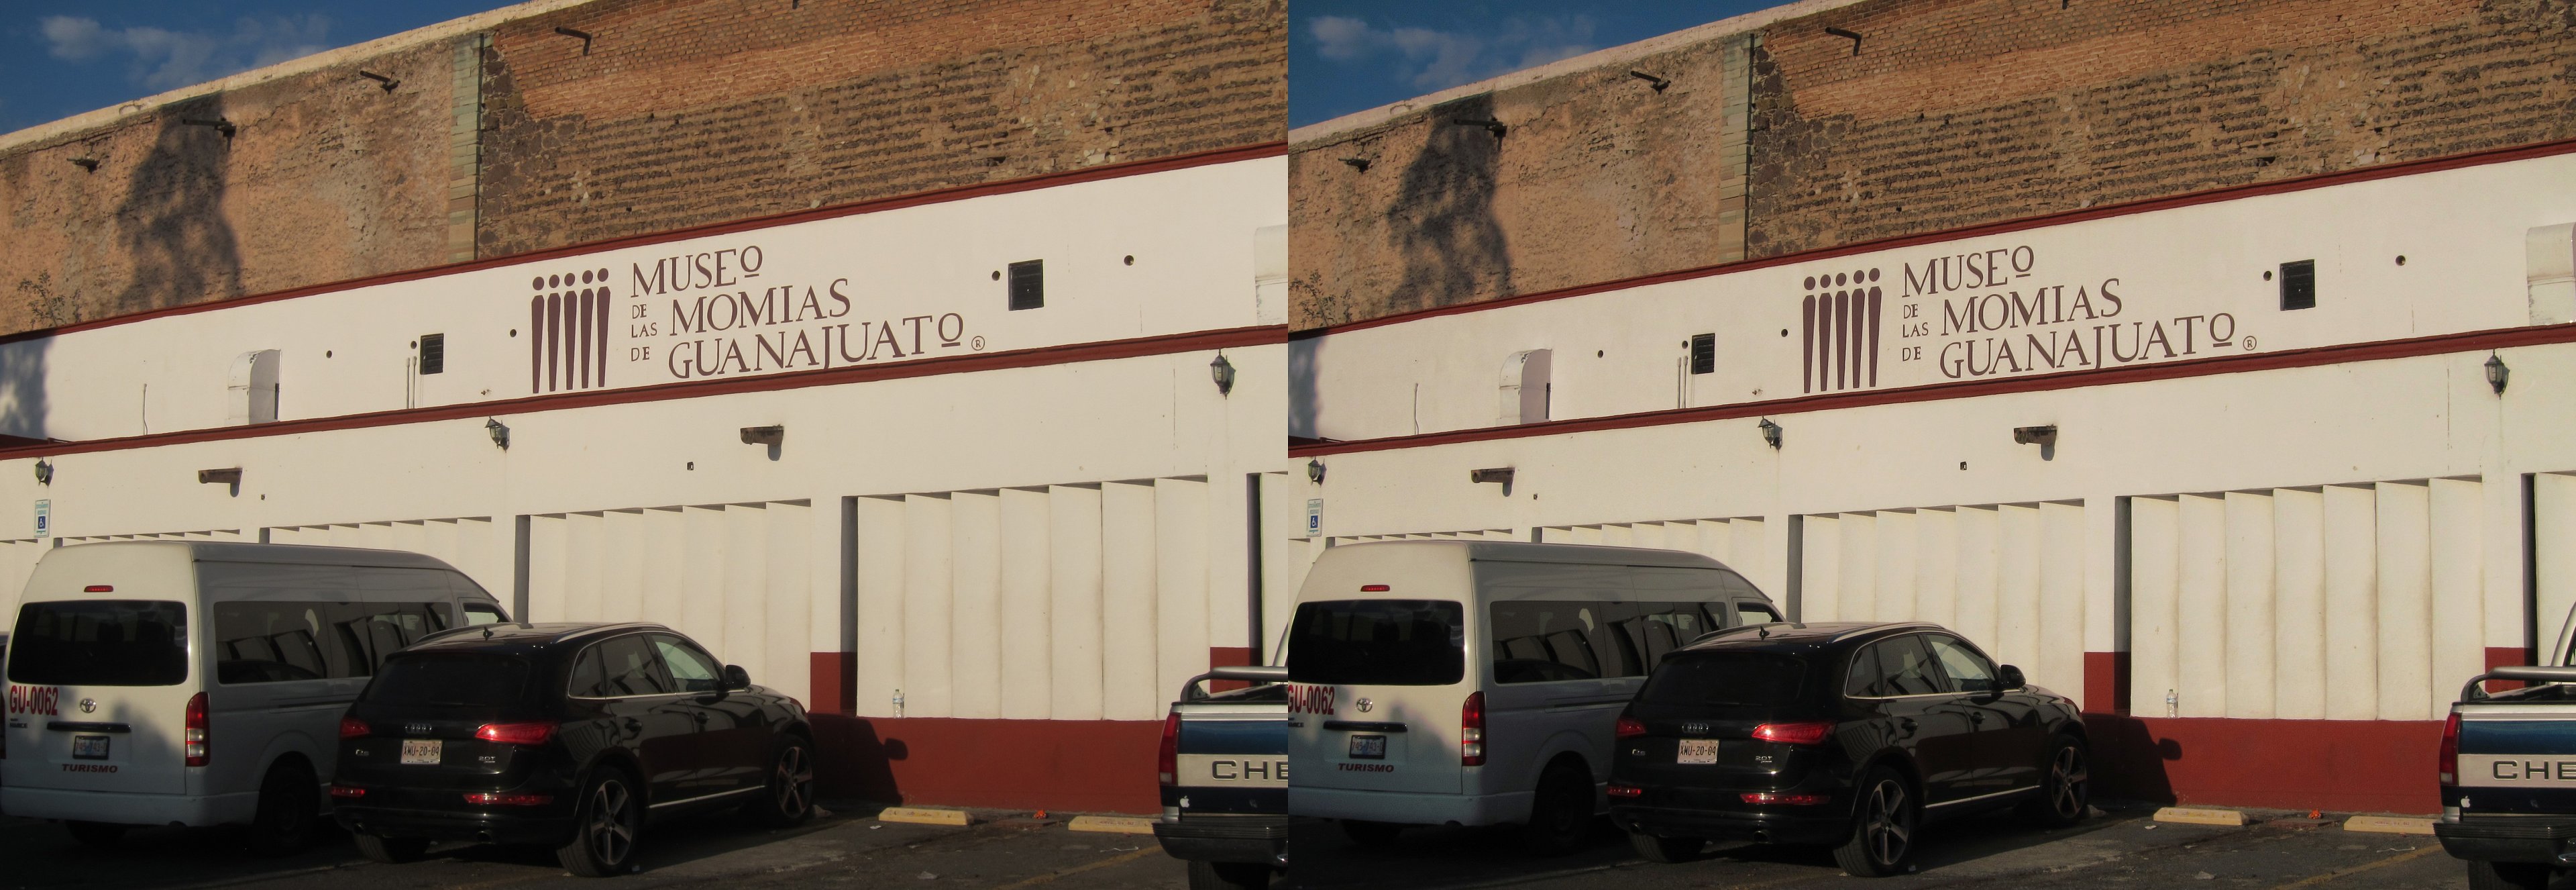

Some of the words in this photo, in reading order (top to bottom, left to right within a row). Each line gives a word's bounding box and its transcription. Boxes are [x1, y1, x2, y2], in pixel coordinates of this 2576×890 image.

[632, 303, 647, 319] DE
[669, 278, 851, 336] MOMIAS
[1903, 303, 1919, 319] DE
[1940, 278, 2123, 336] MOMIAS
[631, 322, 657, 338] LAS
[1902, 322, 1929, 338] LAS
[668, 313, 963, 379] GUANAJUATO
[1902, 346, 1921, 361] DE
[1939, 313, 2235, 379] GUANAJUATO
[631, 347, 650, 362] DE
[10, 685, 58, 716] GU-0062
[62, 763, 118, 773] TURISMO
[1338, 762, 1395, 773] TURISMO
